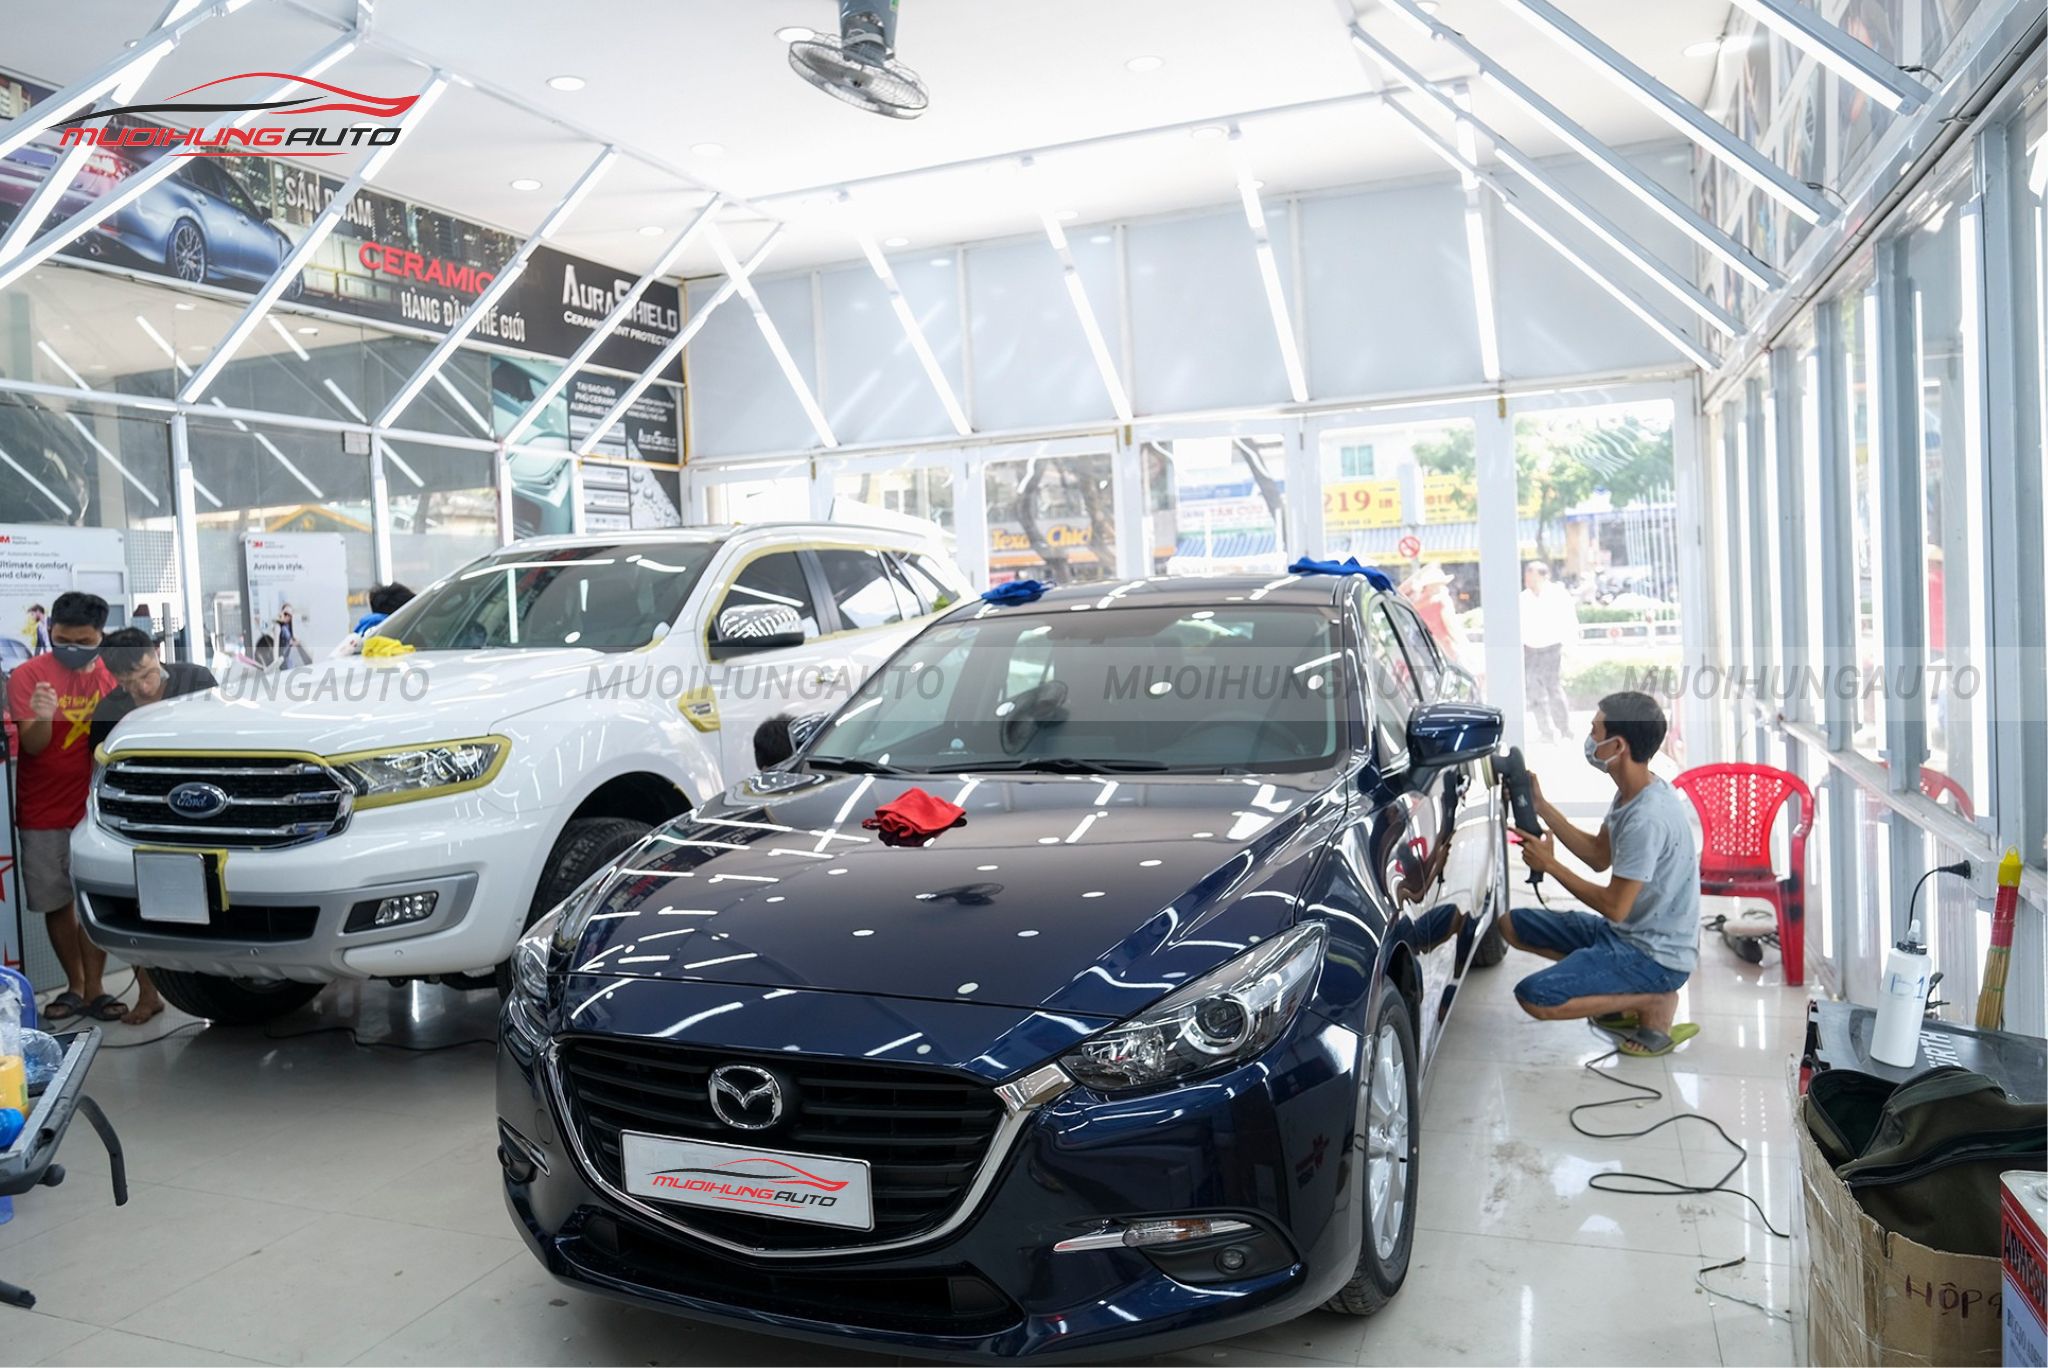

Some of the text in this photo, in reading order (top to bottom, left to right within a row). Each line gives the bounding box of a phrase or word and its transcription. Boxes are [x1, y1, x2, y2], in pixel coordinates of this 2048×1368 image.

[285, 172, 372, 228] SẢN PM
[358, 241, 494, 295] CERAMIC
[401, 286, 441, 324] HÀNG
[500, 312, 526, 343] GIỚI
